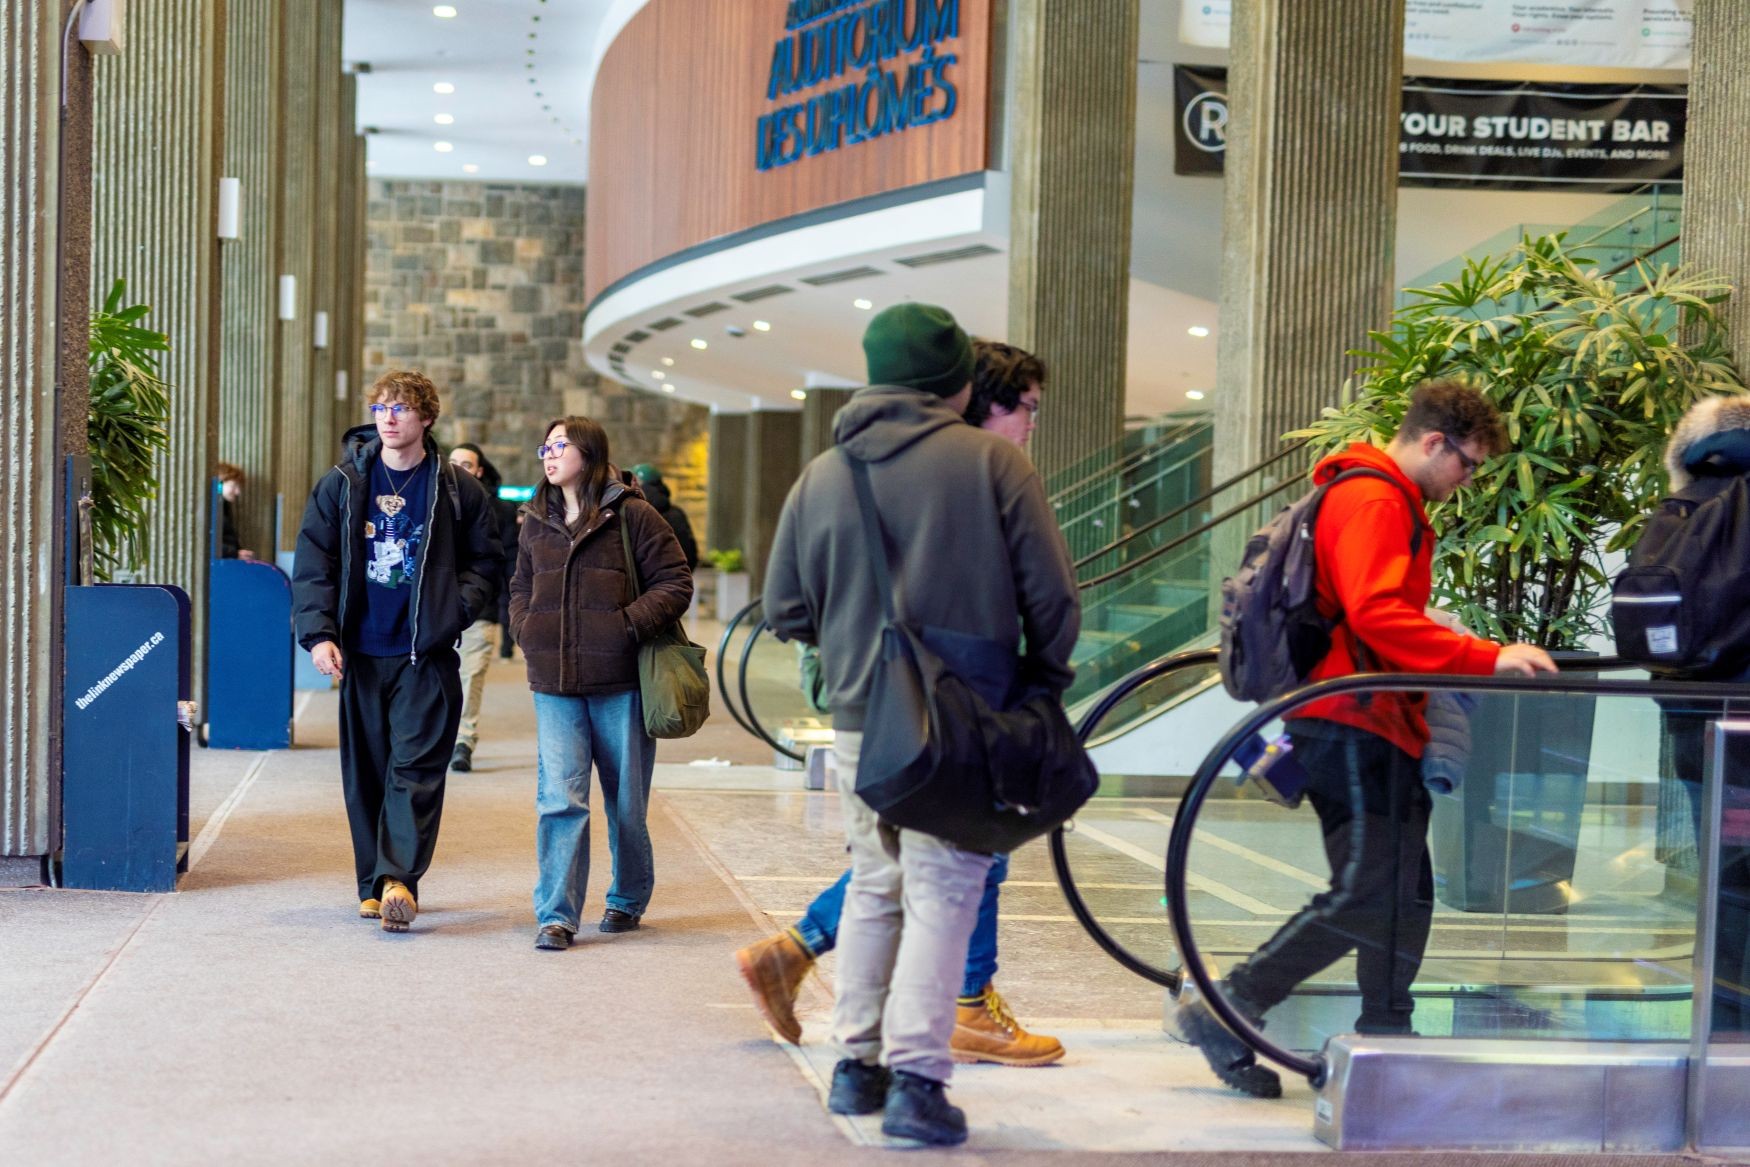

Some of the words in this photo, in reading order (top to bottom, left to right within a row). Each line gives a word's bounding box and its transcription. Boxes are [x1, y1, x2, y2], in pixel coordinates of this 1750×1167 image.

[767, 0, 960, 101] AUDITORIUM
[756, 103, 804, 173] DES
[806, 46, 958, 158] DIPLÔMÉS
[1473, 115, 1604, 141] STUDENT
[1612, 119, 1670, 142] BAR
[1518, 146, 1540, 157] LIVE
[1610, 148, 1635, 159] AND
[75, 631, 165, 710] thelinknewspaper.ca
